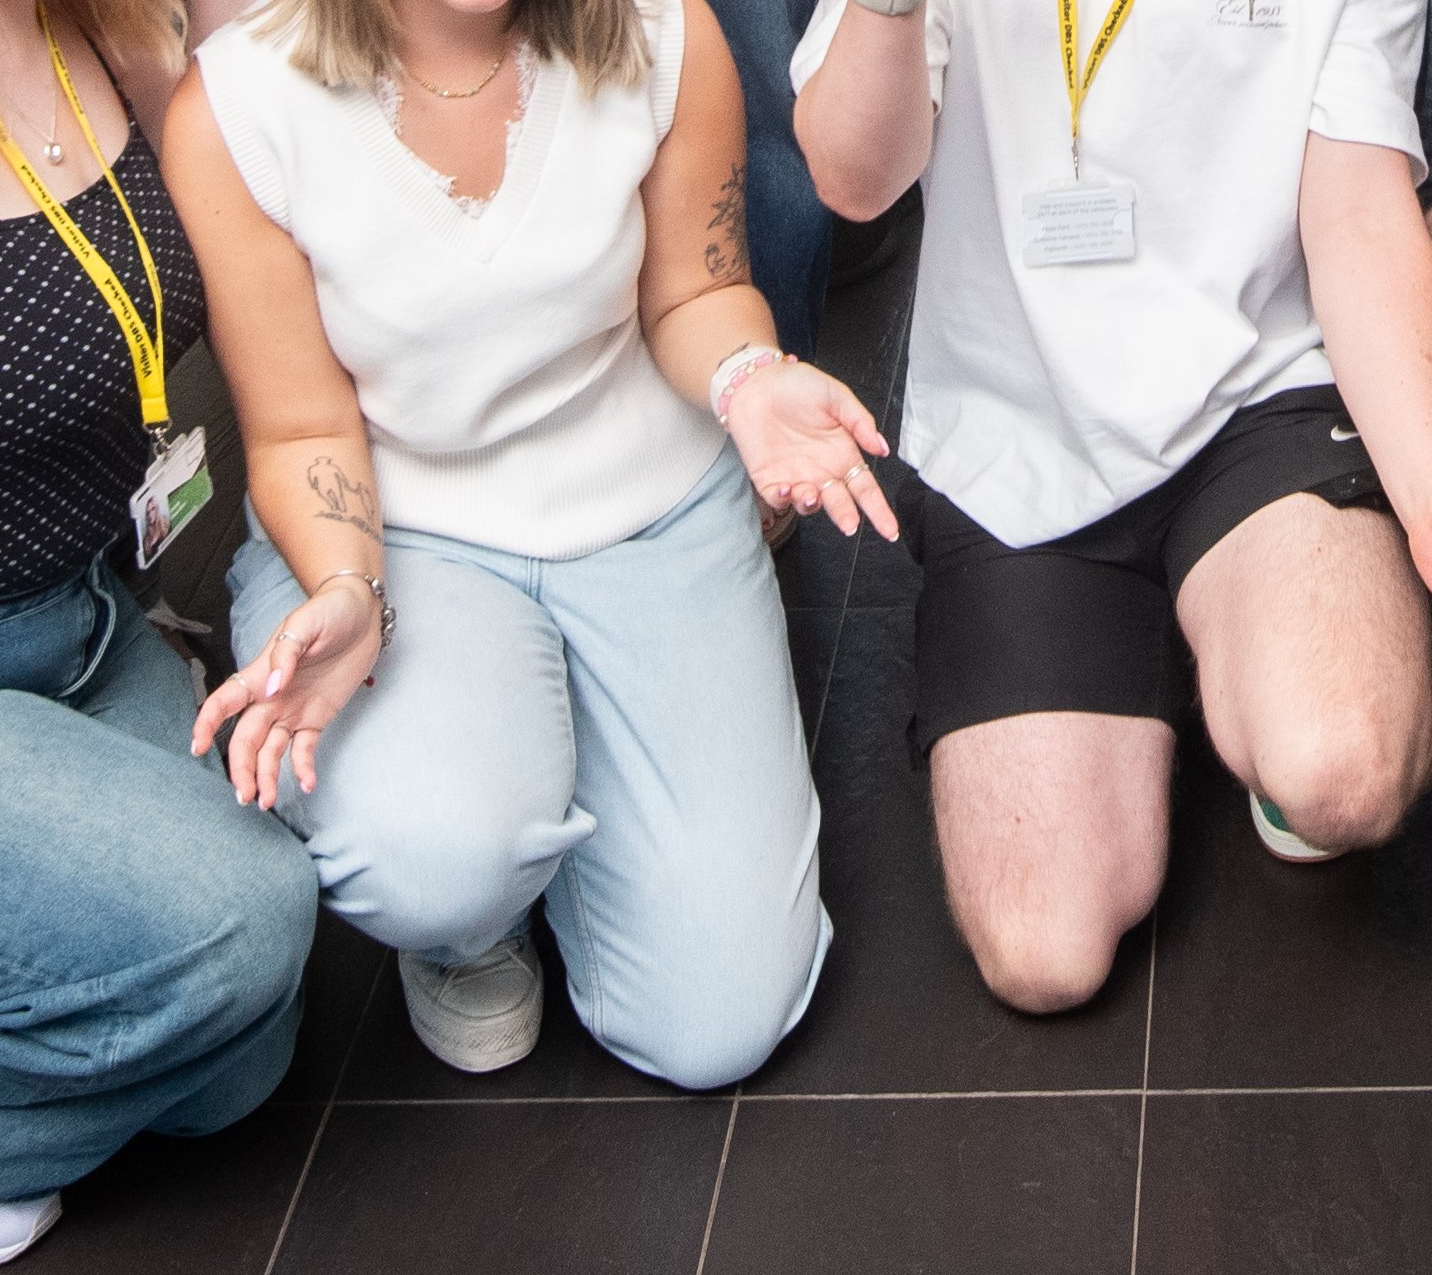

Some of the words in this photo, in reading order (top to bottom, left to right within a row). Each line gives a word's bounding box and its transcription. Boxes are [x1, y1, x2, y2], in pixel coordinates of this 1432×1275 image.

[19, 164, 52, 204] Checked
[50, 204, 66, 225] DBS
[65, 225, 91, 259] Visitor
